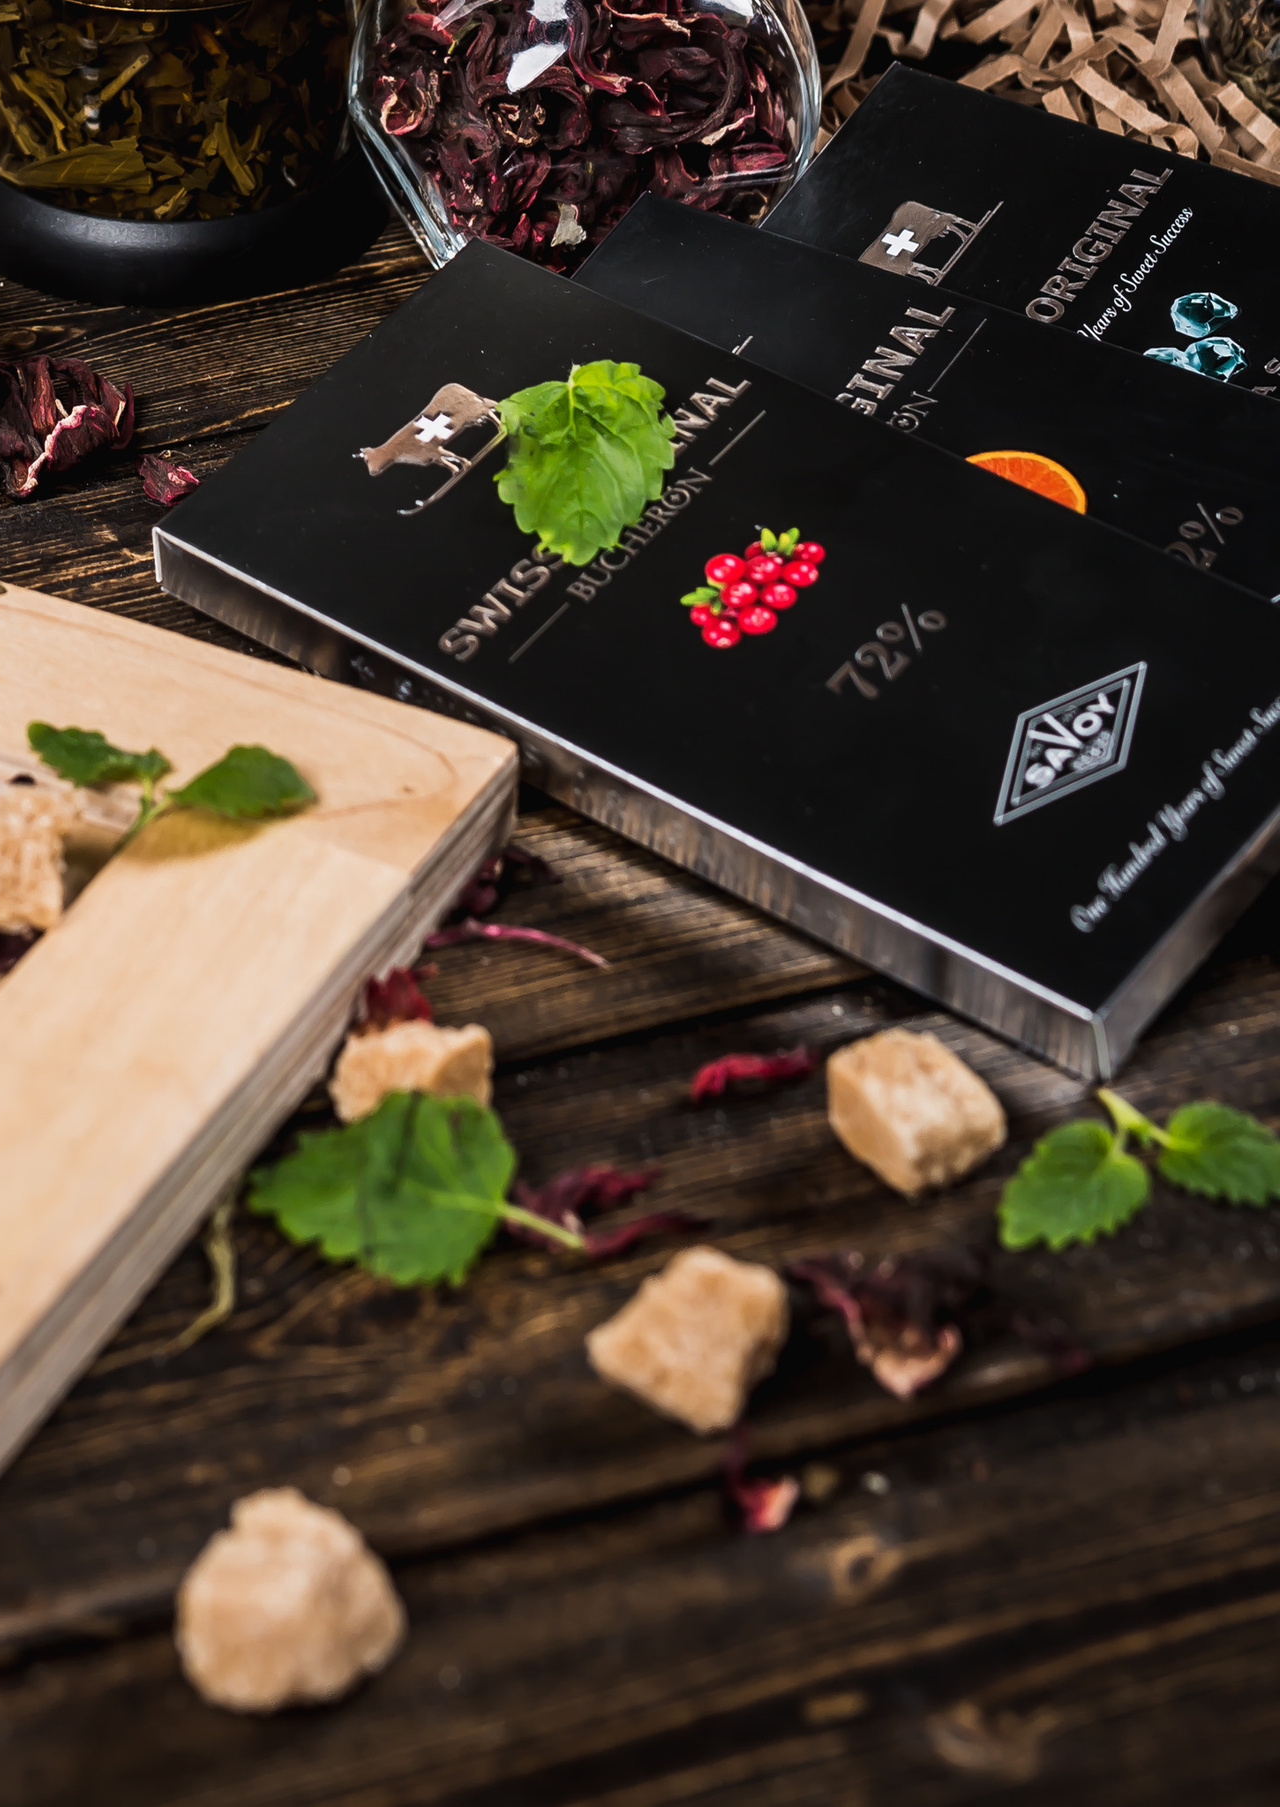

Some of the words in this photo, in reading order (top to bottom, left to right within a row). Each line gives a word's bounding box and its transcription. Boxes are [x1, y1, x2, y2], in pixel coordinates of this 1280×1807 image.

[1025, 167, 1174, 324] ORIGINAL
[1149, 207, 1193, 254] Success
[1113, 284, 1132, 312] of
[1120, 253, 1158, 293] Sweet
[1077, 306, 1118, 342] Years
[825, 602, 948, 700] 72%
[1024, 691, 1116, 790] SAVOY
[1069, 893, 1111, 934] One
[1200, 759, 1226, 801] of
